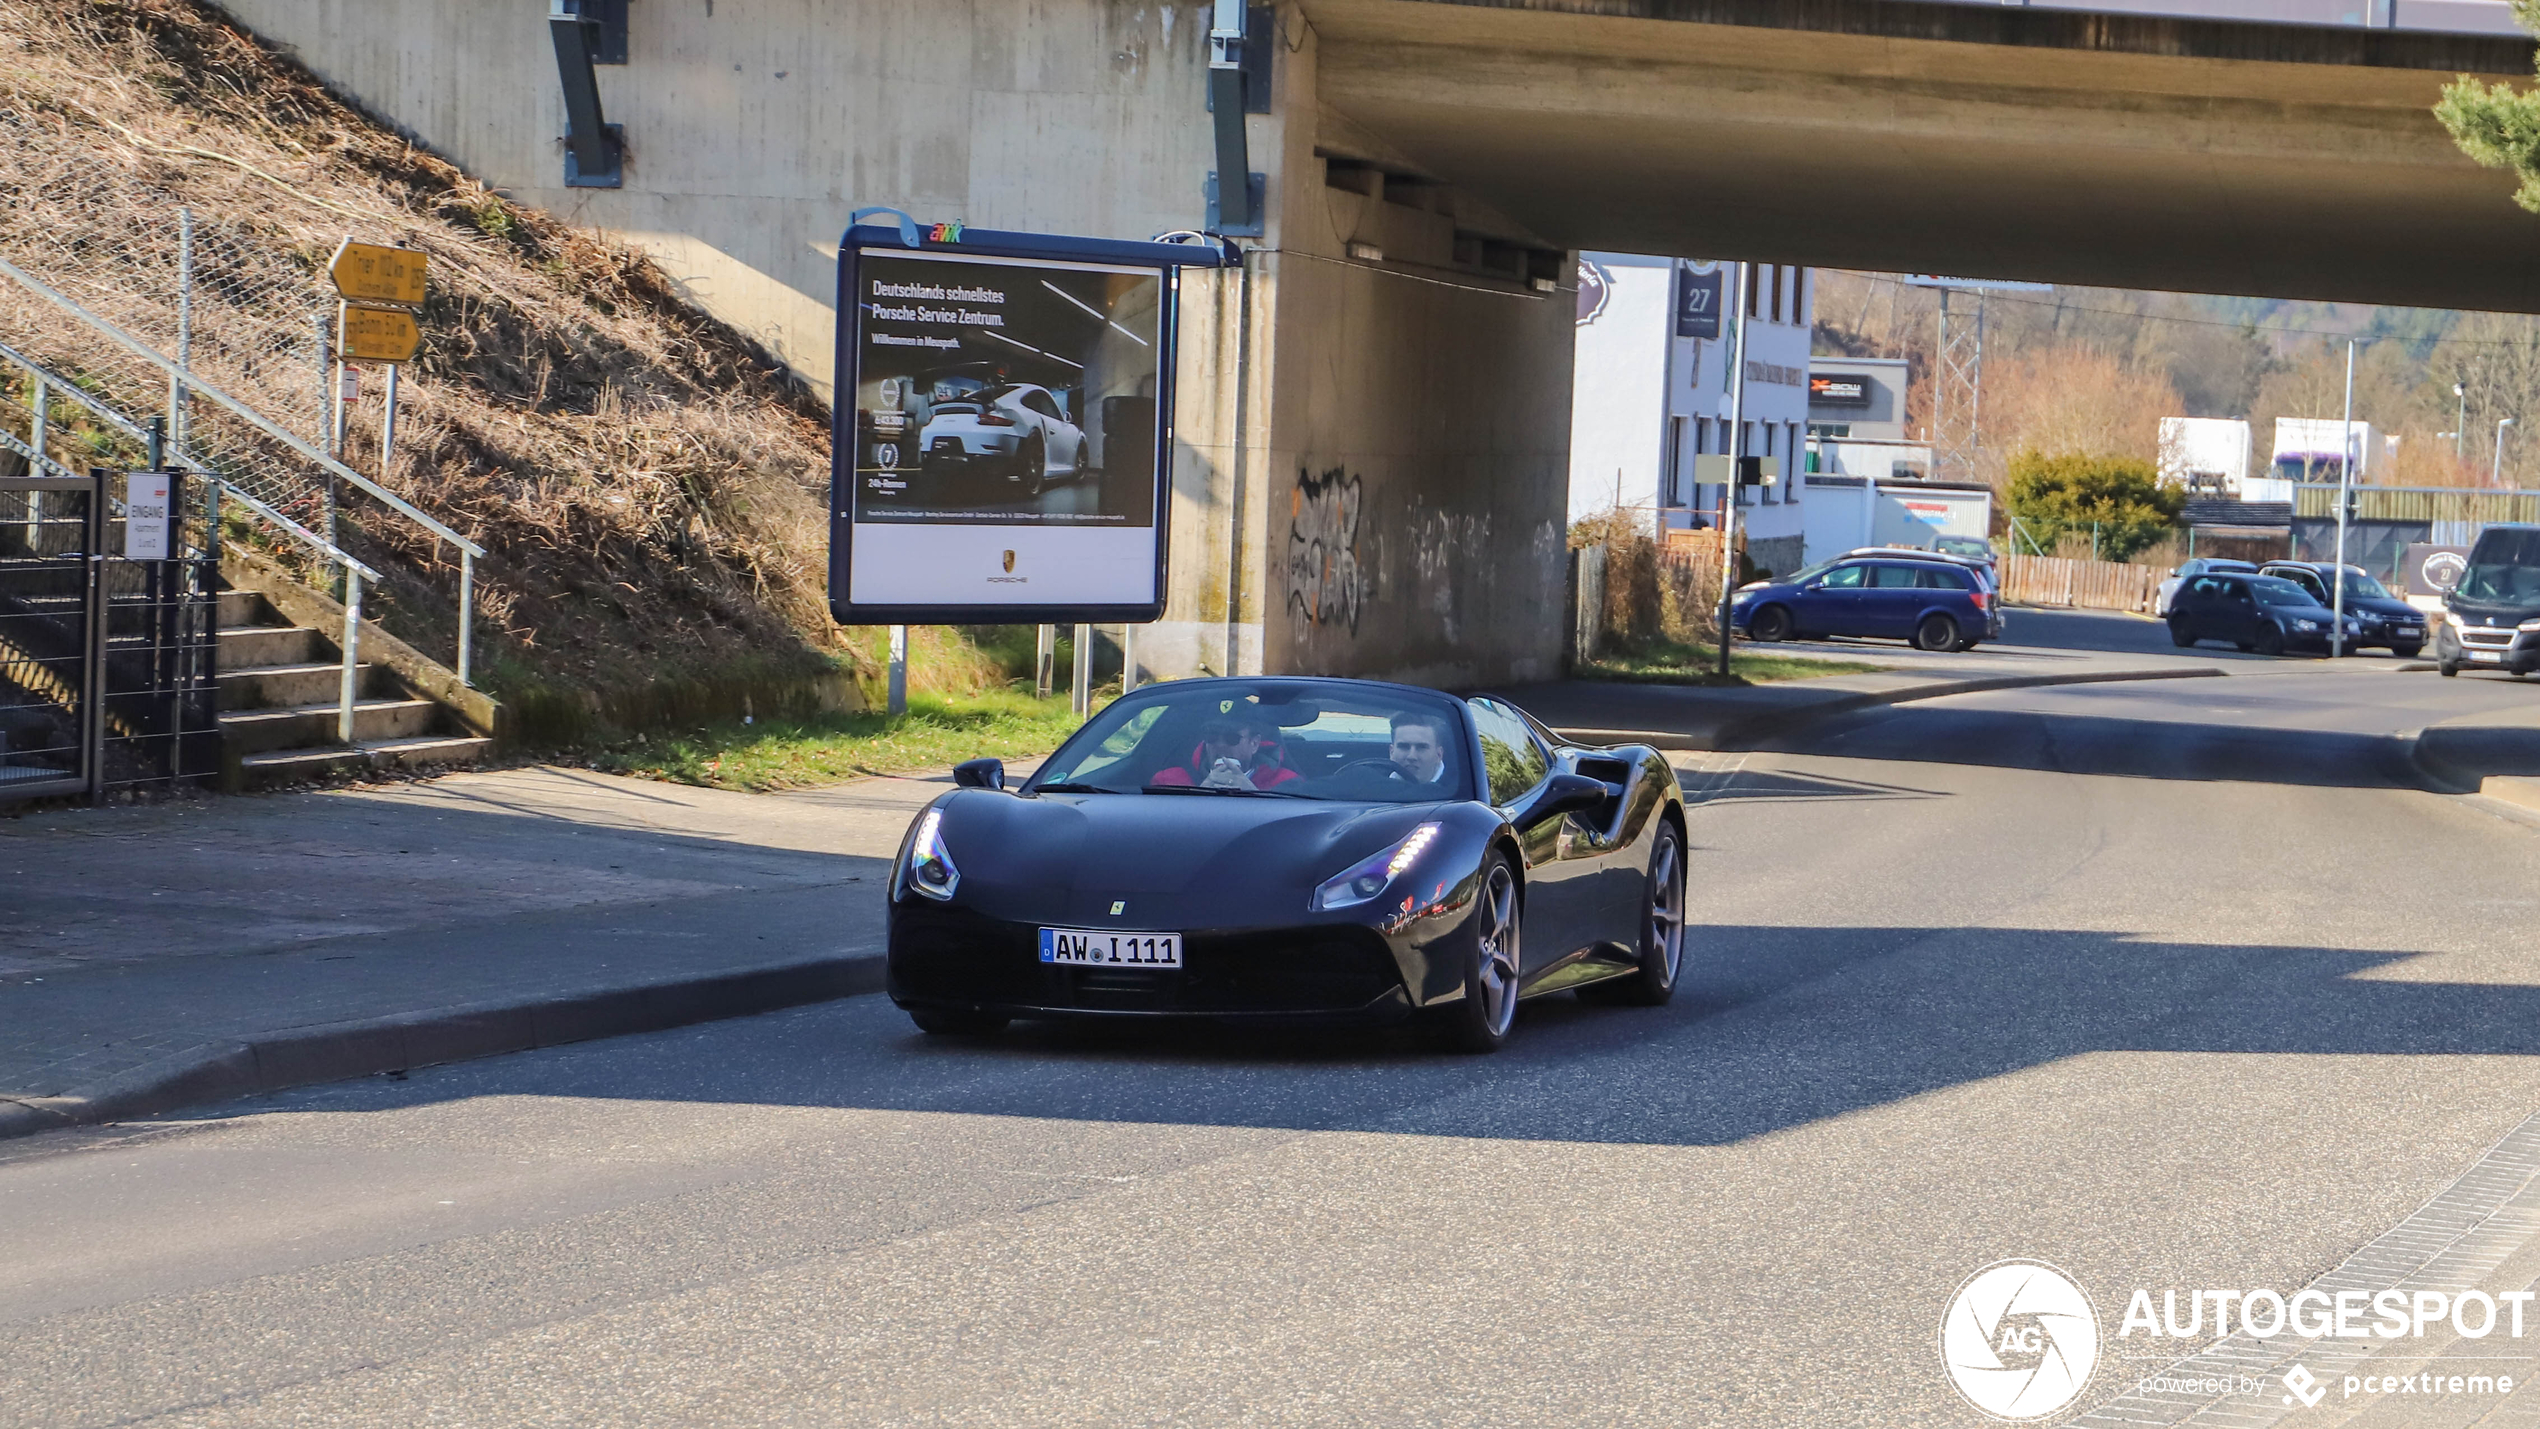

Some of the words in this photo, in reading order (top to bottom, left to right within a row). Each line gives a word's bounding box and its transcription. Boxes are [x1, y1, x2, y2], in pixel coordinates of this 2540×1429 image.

[929, 218, 963, 243] awk
[353, 250, 375, 274] Trier
[872, 279, 946, 300] Deutschlands
[946, 285, 1005, 304] schnellstes
[1688, 287, 1711, 312] 27
[358, 311, 382, 335] Bonn
[872, 302, 916, 321] Porsche
[917, 305, 957, 324] Service
[957, 308, 1005, 326] Zentrum.
[871, 332, 916, 346] Willkommen
[916, 335, 924, 346] in
[924, 336, 961, 350] Meuspath.
[884, 450, 892, 463] 7
[867, 478, 907, 489] 24h-Rennen
[132, 505, 163, 519] EINGANG
[2440, 568, 2451, 580] 27
[1056, 934, 1087, 961] AW
